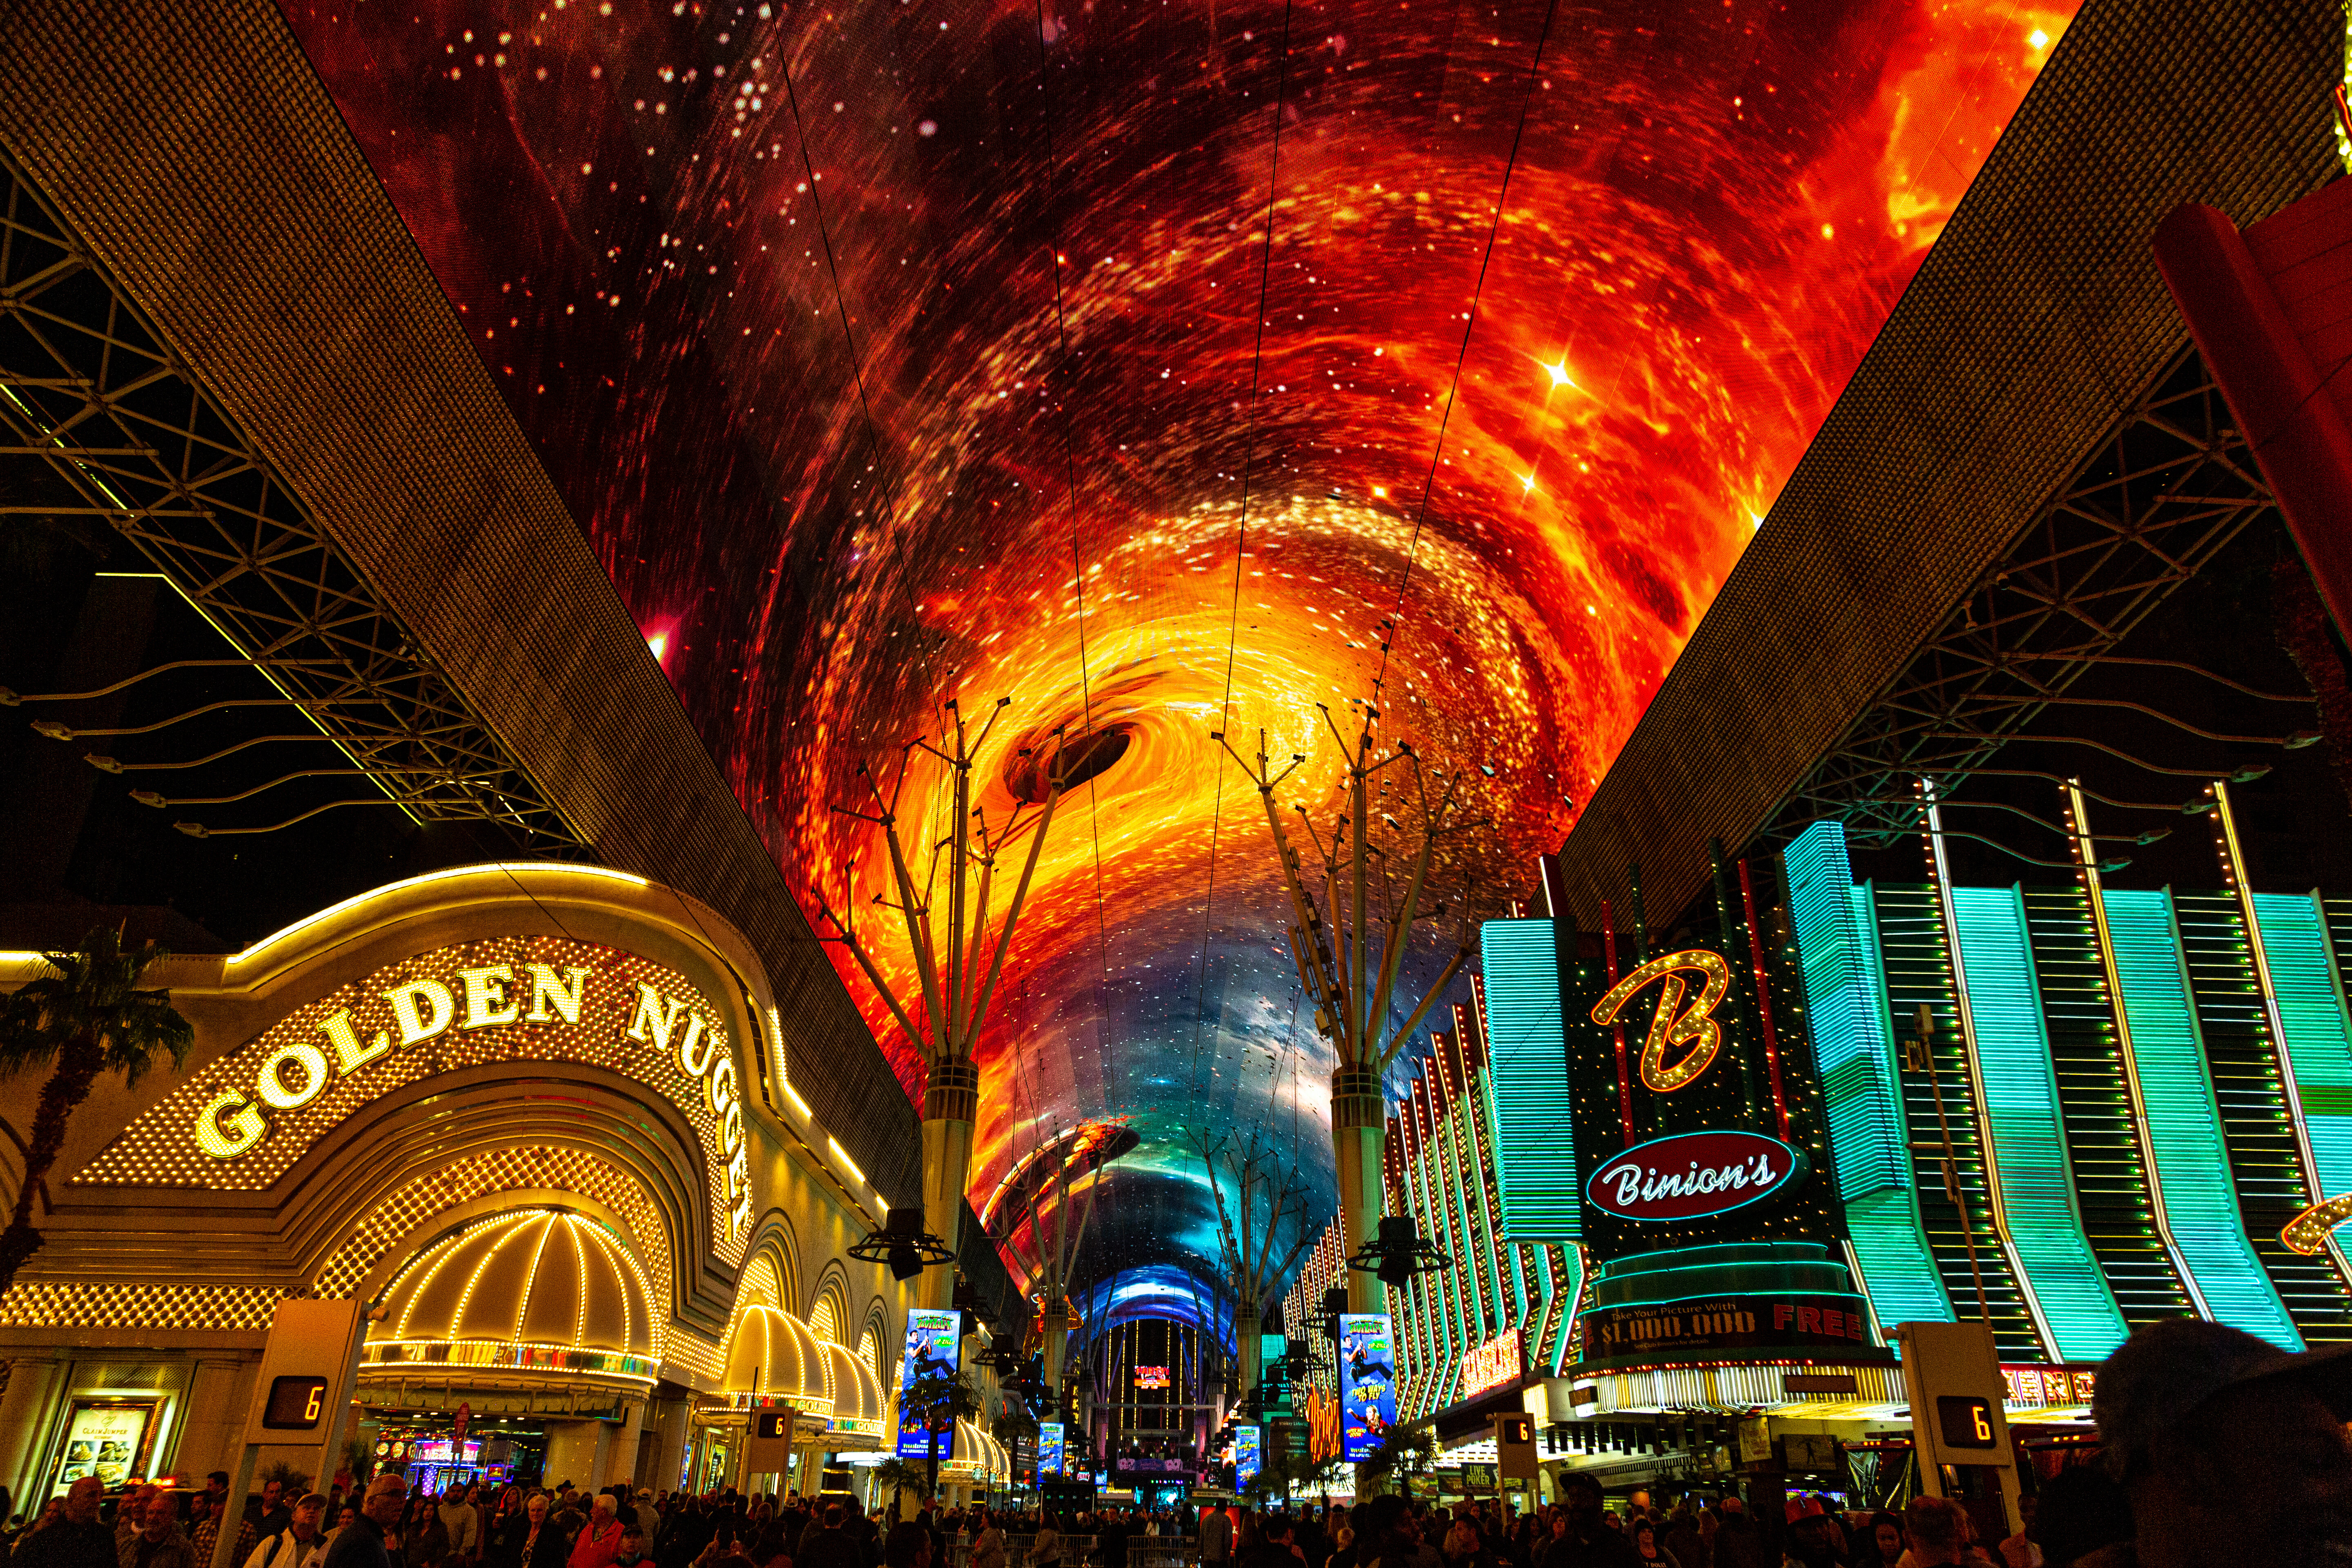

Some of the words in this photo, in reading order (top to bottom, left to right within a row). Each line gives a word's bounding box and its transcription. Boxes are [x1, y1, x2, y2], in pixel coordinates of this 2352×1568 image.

[1591, 949, 1729, 1092] B
[196, 962, 592, 1159] GOLDEN
[618, 980, 749, 1241] NUGGET
[1602, 1154, 1776, 1207] Binion's
[1601, 1312, 1755, 1345] $1,000,000
[1611, 1311, 1632, 1322] Take
[1634, 1310, 1658, 1319] Your
[1661, 1305, 1702, 1315] Picture
[1705, 1303, 1736, 1312] With
[1774, 1304, 1863, 1341] FREE
[1463, 1326, 1521, 1399] GAMBLING
[305, 1387, 324, 1420] 6
[1352, 1385, 1366, 1397] TWO
[1368, 1383, 1386, 1393] WAYS
[1358, 1394, 1367, 1402] TO
[1369, 1392, 1380, 1400] FLY
[776, 1417, 783, 1434] 6
[1520, 1423, 1528, 1440] 6
[1972, 1407, 1991, 1440] 6
[1467, 1476, 1490, 1485] POKER
[1470, 1466, 1485, 1476] LIVE
